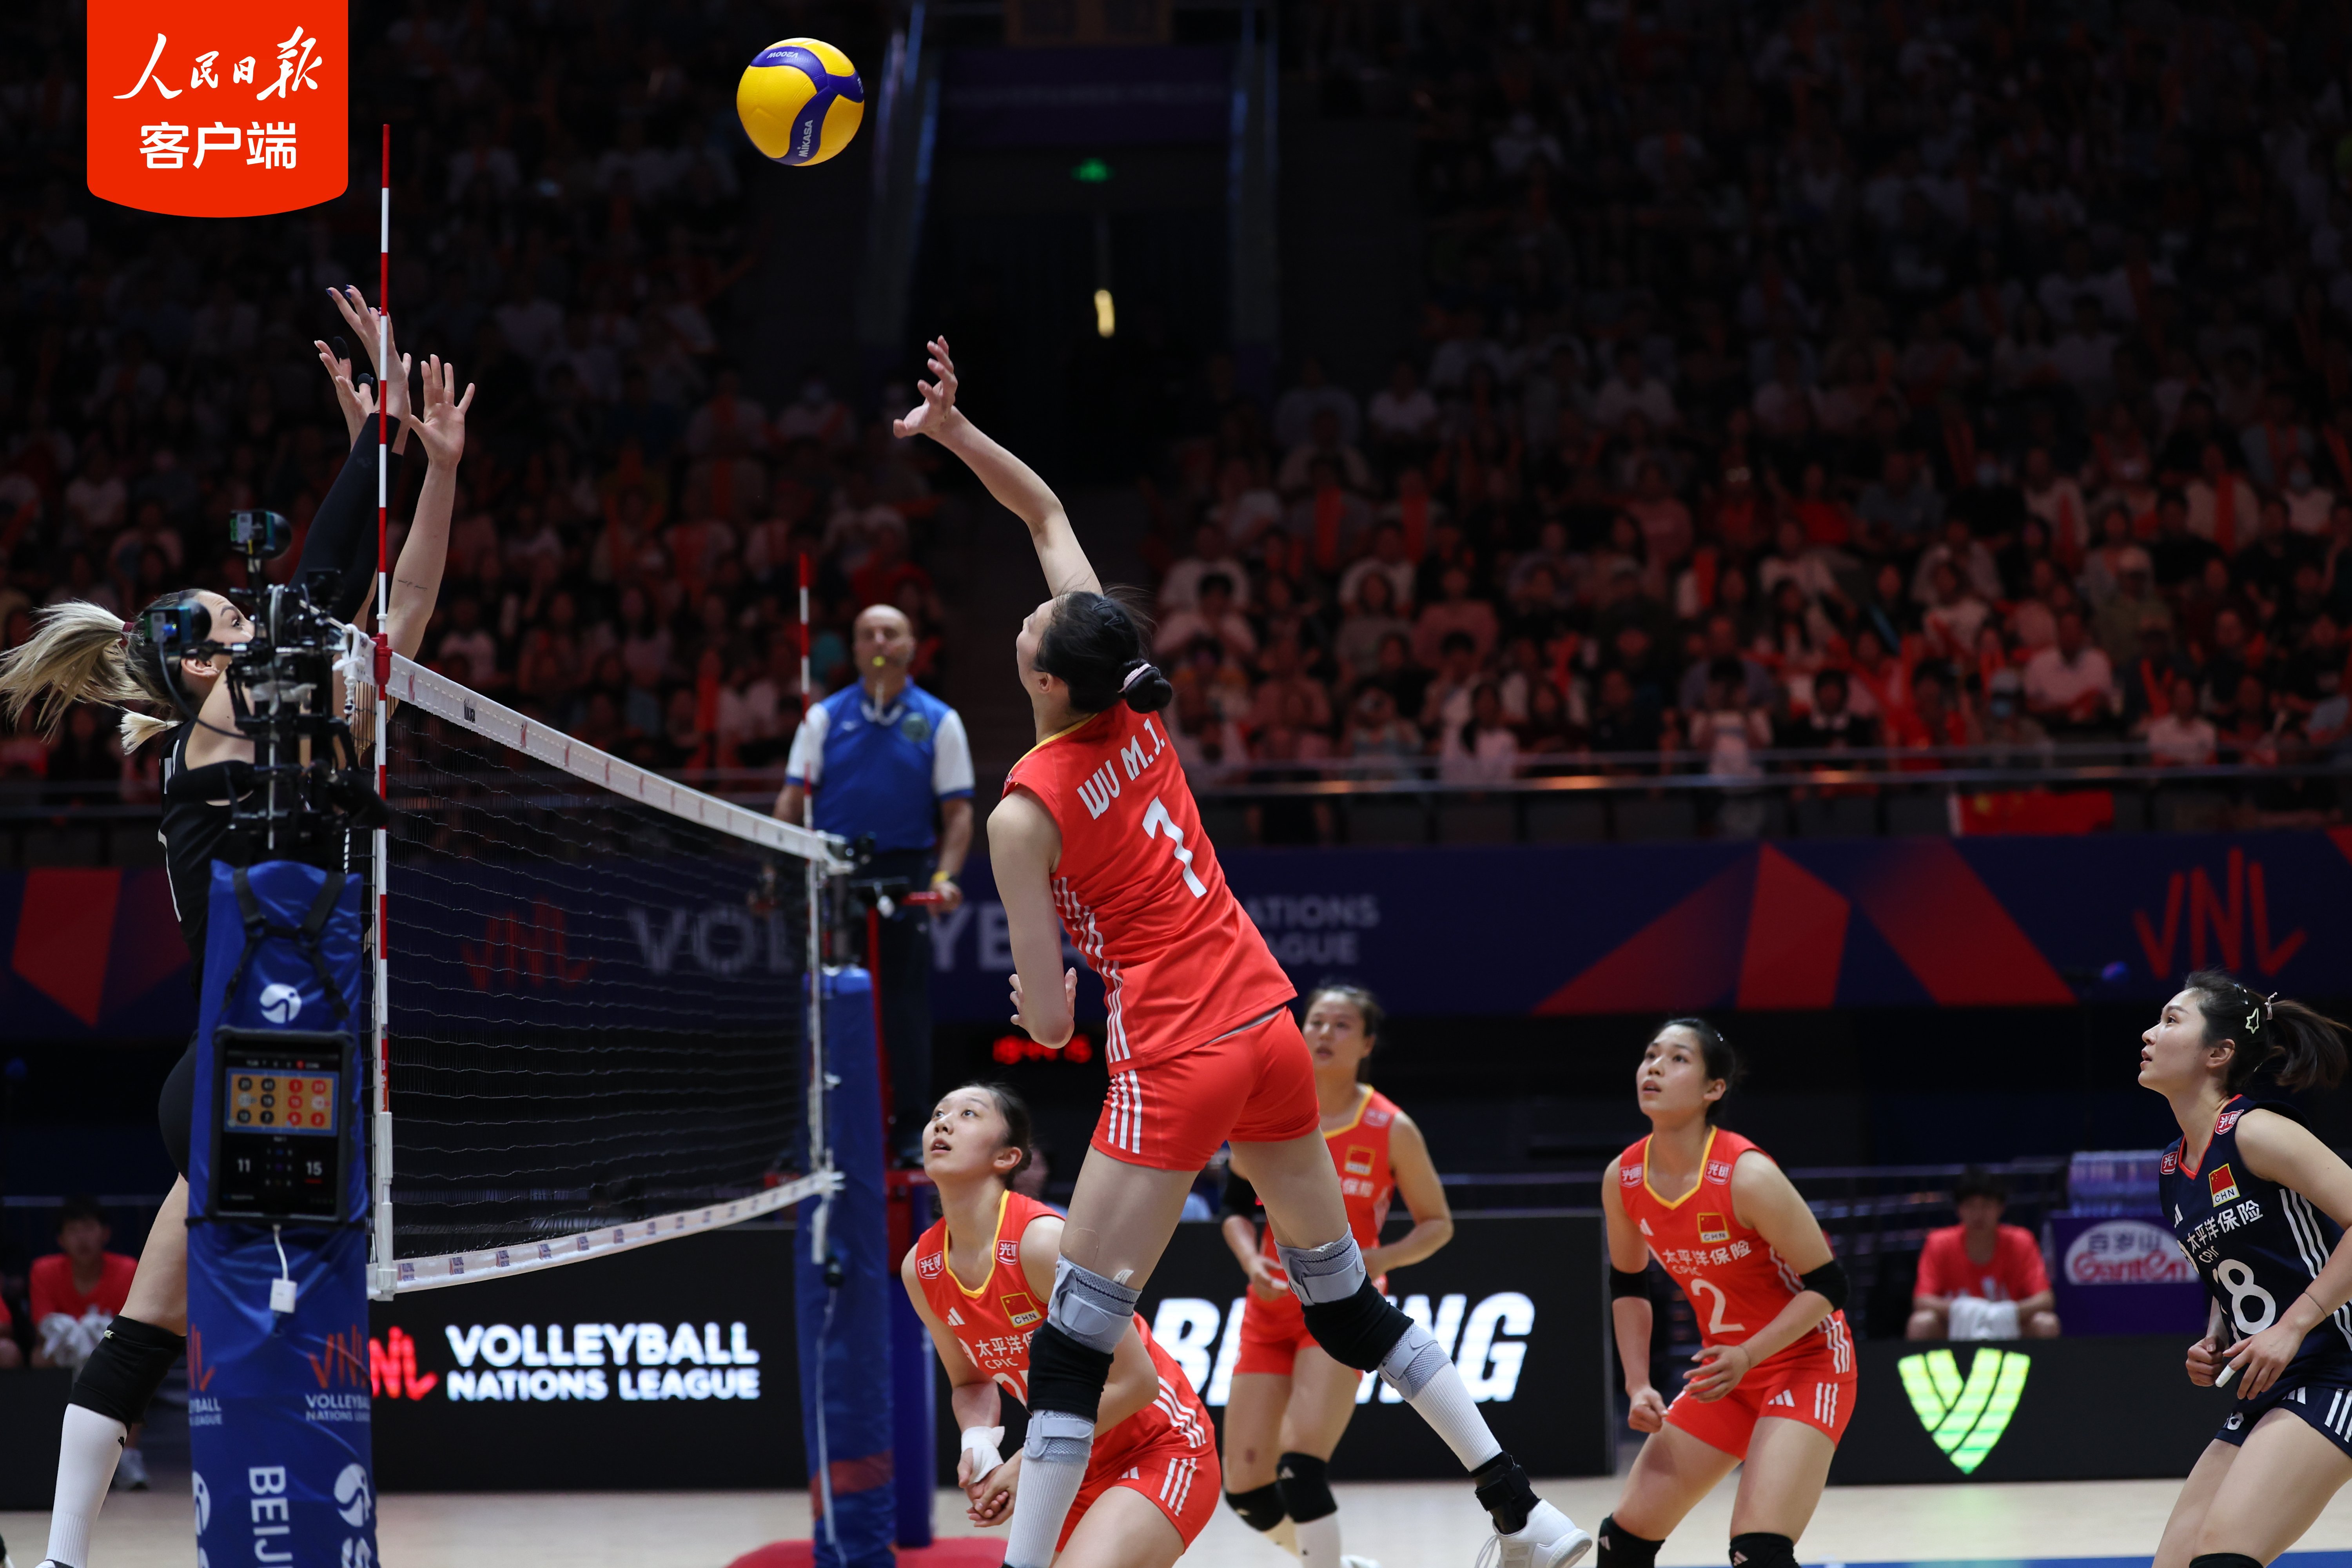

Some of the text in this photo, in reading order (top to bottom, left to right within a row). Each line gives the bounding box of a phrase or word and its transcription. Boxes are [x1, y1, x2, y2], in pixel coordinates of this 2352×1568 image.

[1076, 718, 1165, 820] WU M.J.
[1142, 795, 1207, 899] 1
[2133, 846, 2307, 981] VNL
[238, 1158, 322, 1176] 11 15
[2163, 1154, 2178, 1169] 光
[2215, 1188, 2235, 1203] CHN
[1703, 1233, 1726, 1241] CHN
[2187, 1200, 2263, 1254] 太平洋保险
[1662, 1240, 1752, 1266] 太平洋保险
[1014, 1313, 1037, 1325] CHN
[1690, 1279, 1745, 1335] 2
[445, 1322, 760, 1367] VOLLEYBALL
[984, 1357, 1019, 1369] CPIC
[447, 1367, 760, 1401] NATIONS LEAGUE
